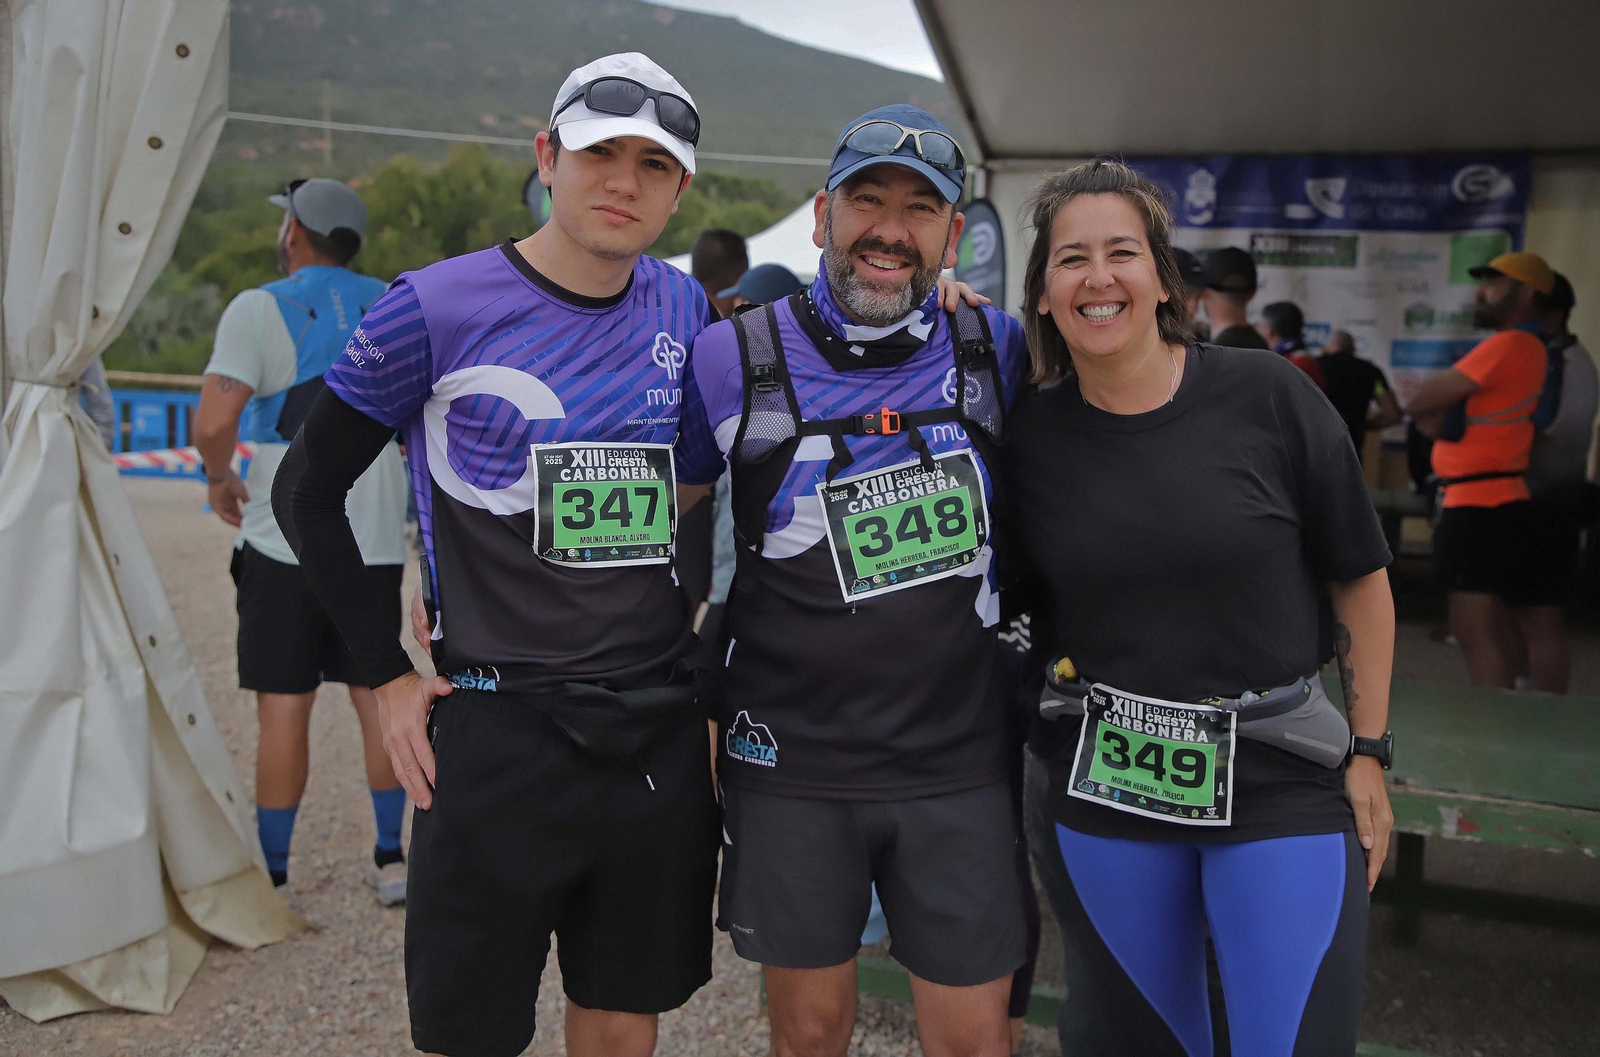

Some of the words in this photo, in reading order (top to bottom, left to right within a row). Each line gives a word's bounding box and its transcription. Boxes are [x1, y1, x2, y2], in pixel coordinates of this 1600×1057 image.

[570, 449, 606, 467] XIII
[608, 449, 646, 458] EDICIÓN
[608, 458, 648, 467] CRESTA
[560, 467, 658, 481] CARBONERA
[854, 474, 895, 500] XIII
[895, 462, 942, 480] EDICIN
[896, 468, 946, 488] CRESTA
[830, 492, 848, 502] 2025
[848, 475, 960, 514] CARBONERA
[561, 487, 659, 530] 347
[580, 536, 603, 544] MOLINA
[604, 535, 629, 543] BLANCA,
[630, 533, 651, 541] ALVARO
[854, 496, 968, 558] 348
[876, 560, 900, 571] MOLINA
[900, 551, 930, 565] HERRERA,
[930, 542, 960, 557] FRANCISCO
[1092, 696, 1106, 706] 2025
[1110, 695, 1144, 720] XIII
[1146, 705, 1196, 720] EDICIÓN
[1103, 710, 1209, 743] CARBONERA
[1145, 714, 1197, 729] CRESTA
[1101, 730, 1207, 788] 349
[1110, 776, 1132, 788] MOLINA
[1132, 782, 1160, 796] HERRERA,
[1161, 788, 1185, 802] ZULEICA
